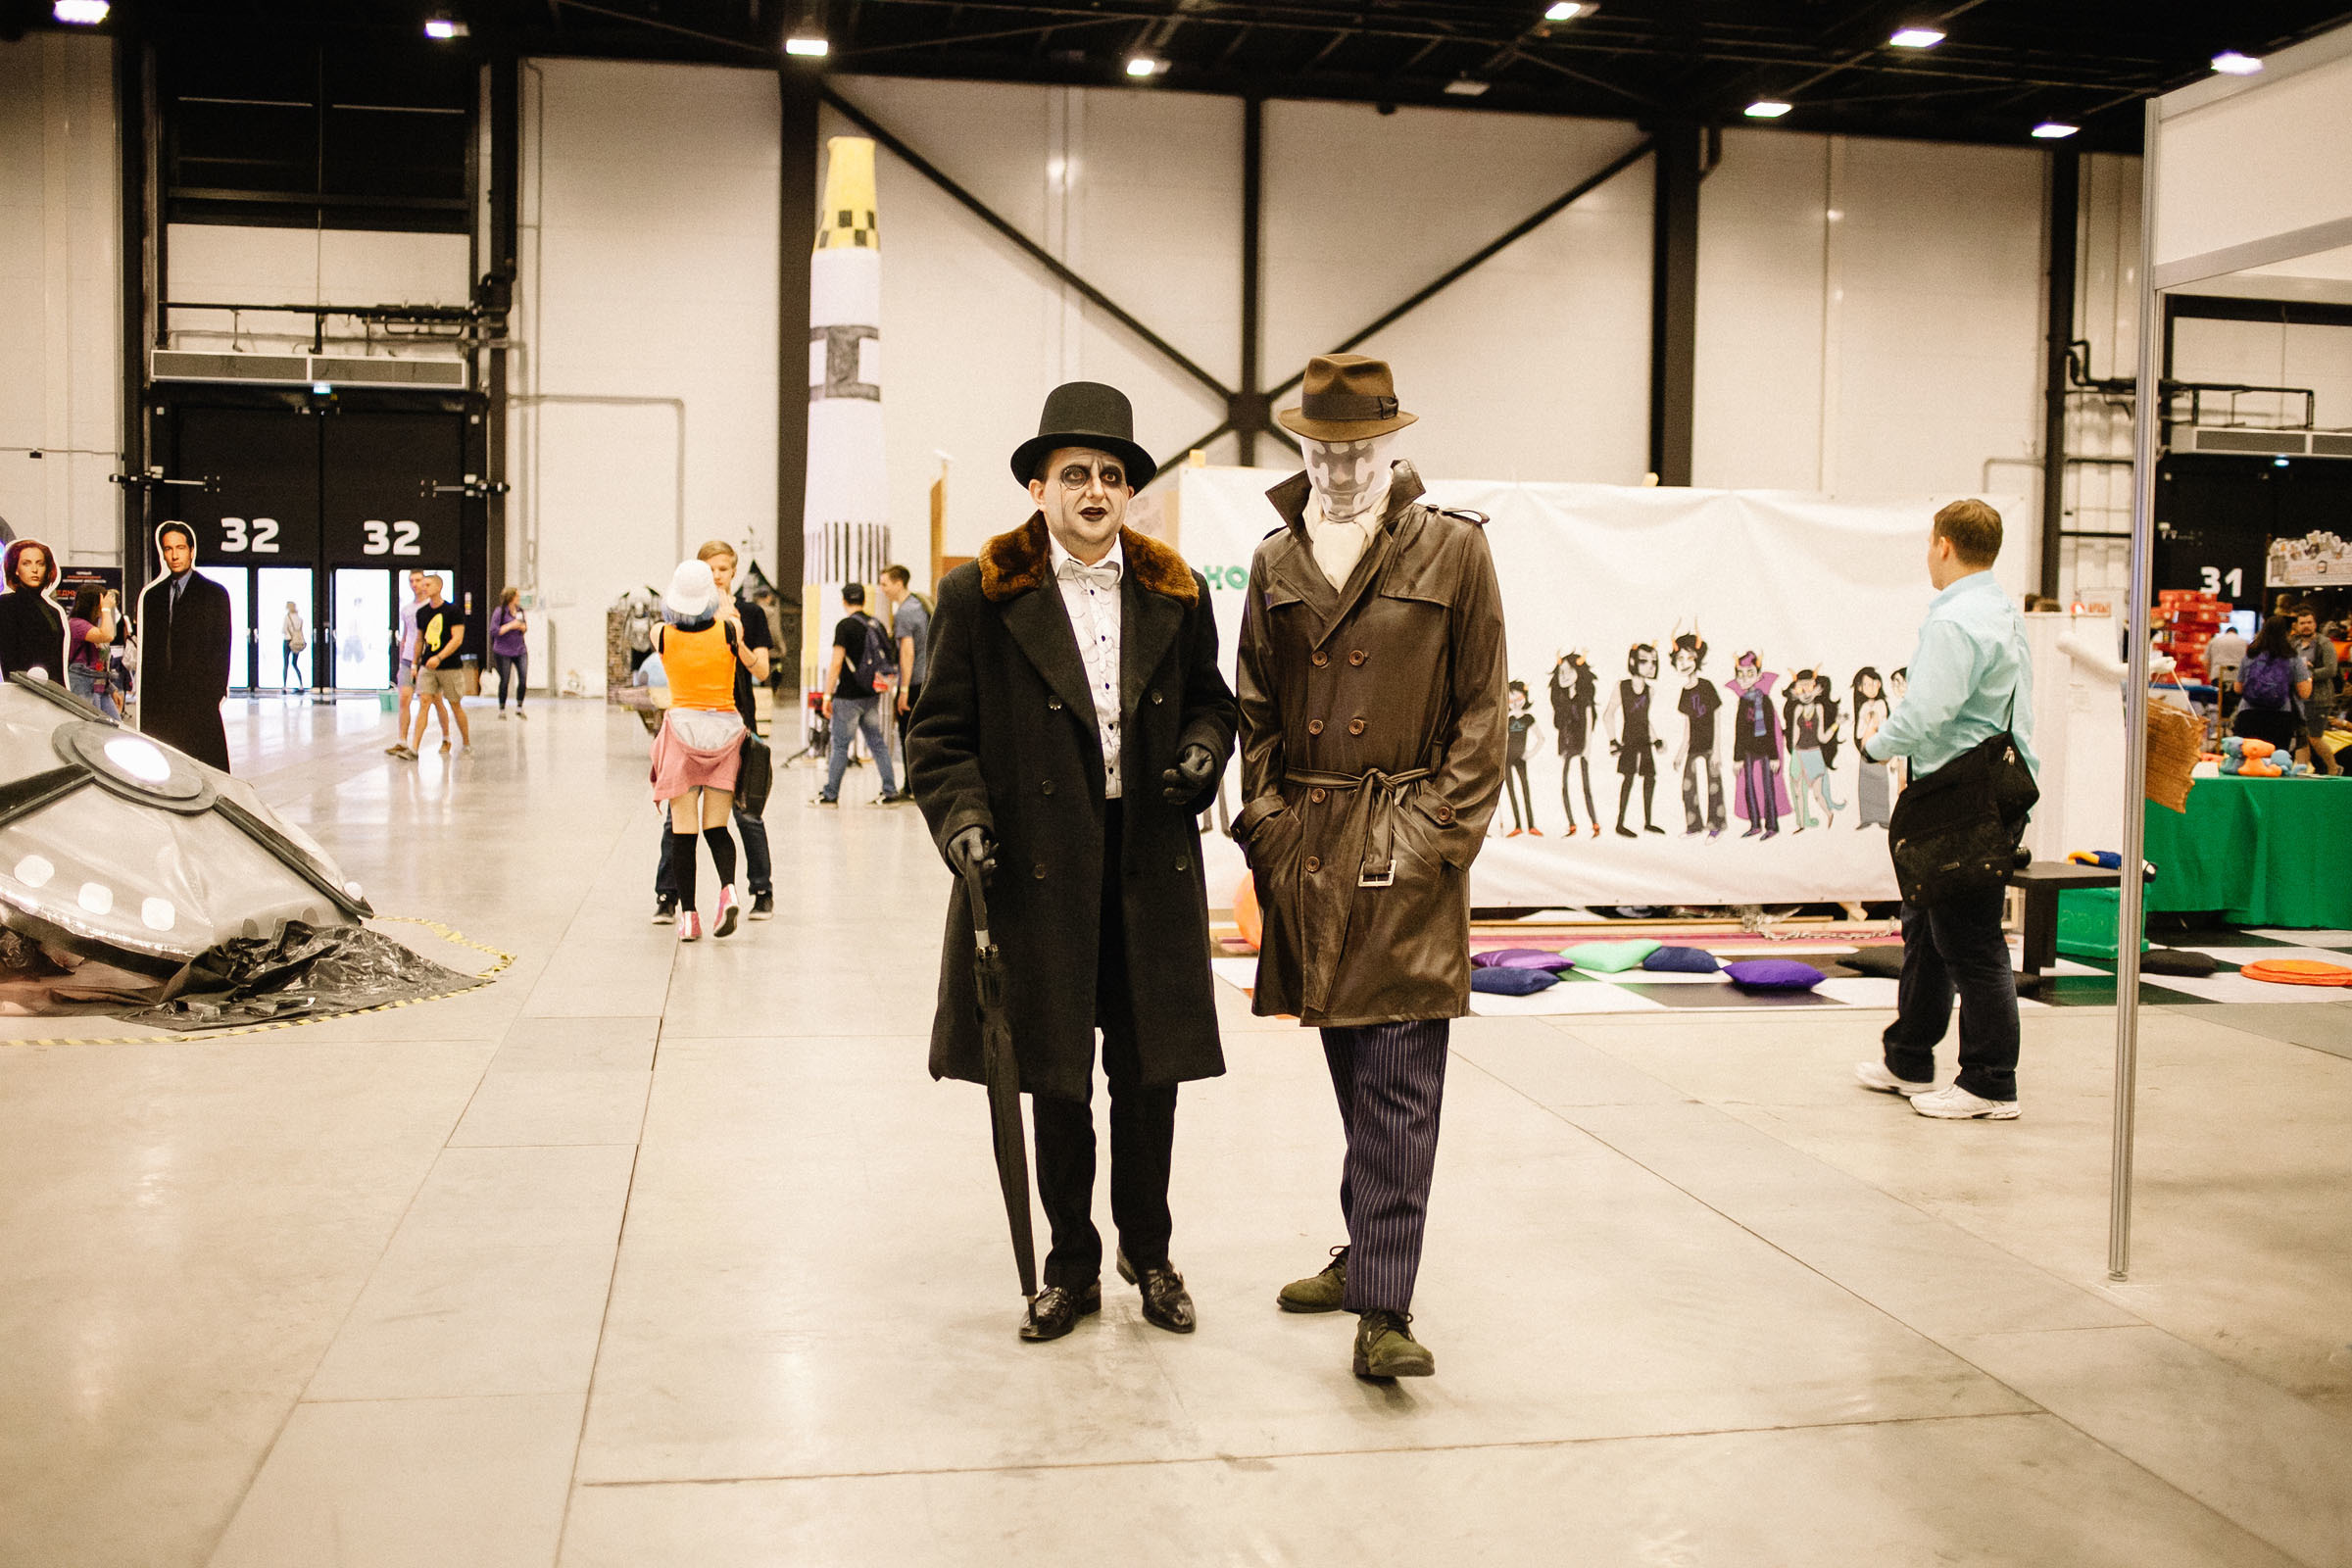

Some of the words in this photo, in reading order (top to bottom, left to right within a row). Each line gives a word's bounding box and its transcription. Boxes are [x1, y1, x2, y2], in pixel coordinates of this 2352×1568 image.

[220, 517, 279, 553] 32
[364, 520, 421, 556] 32
[2199, 566, 2242, 598] 31
